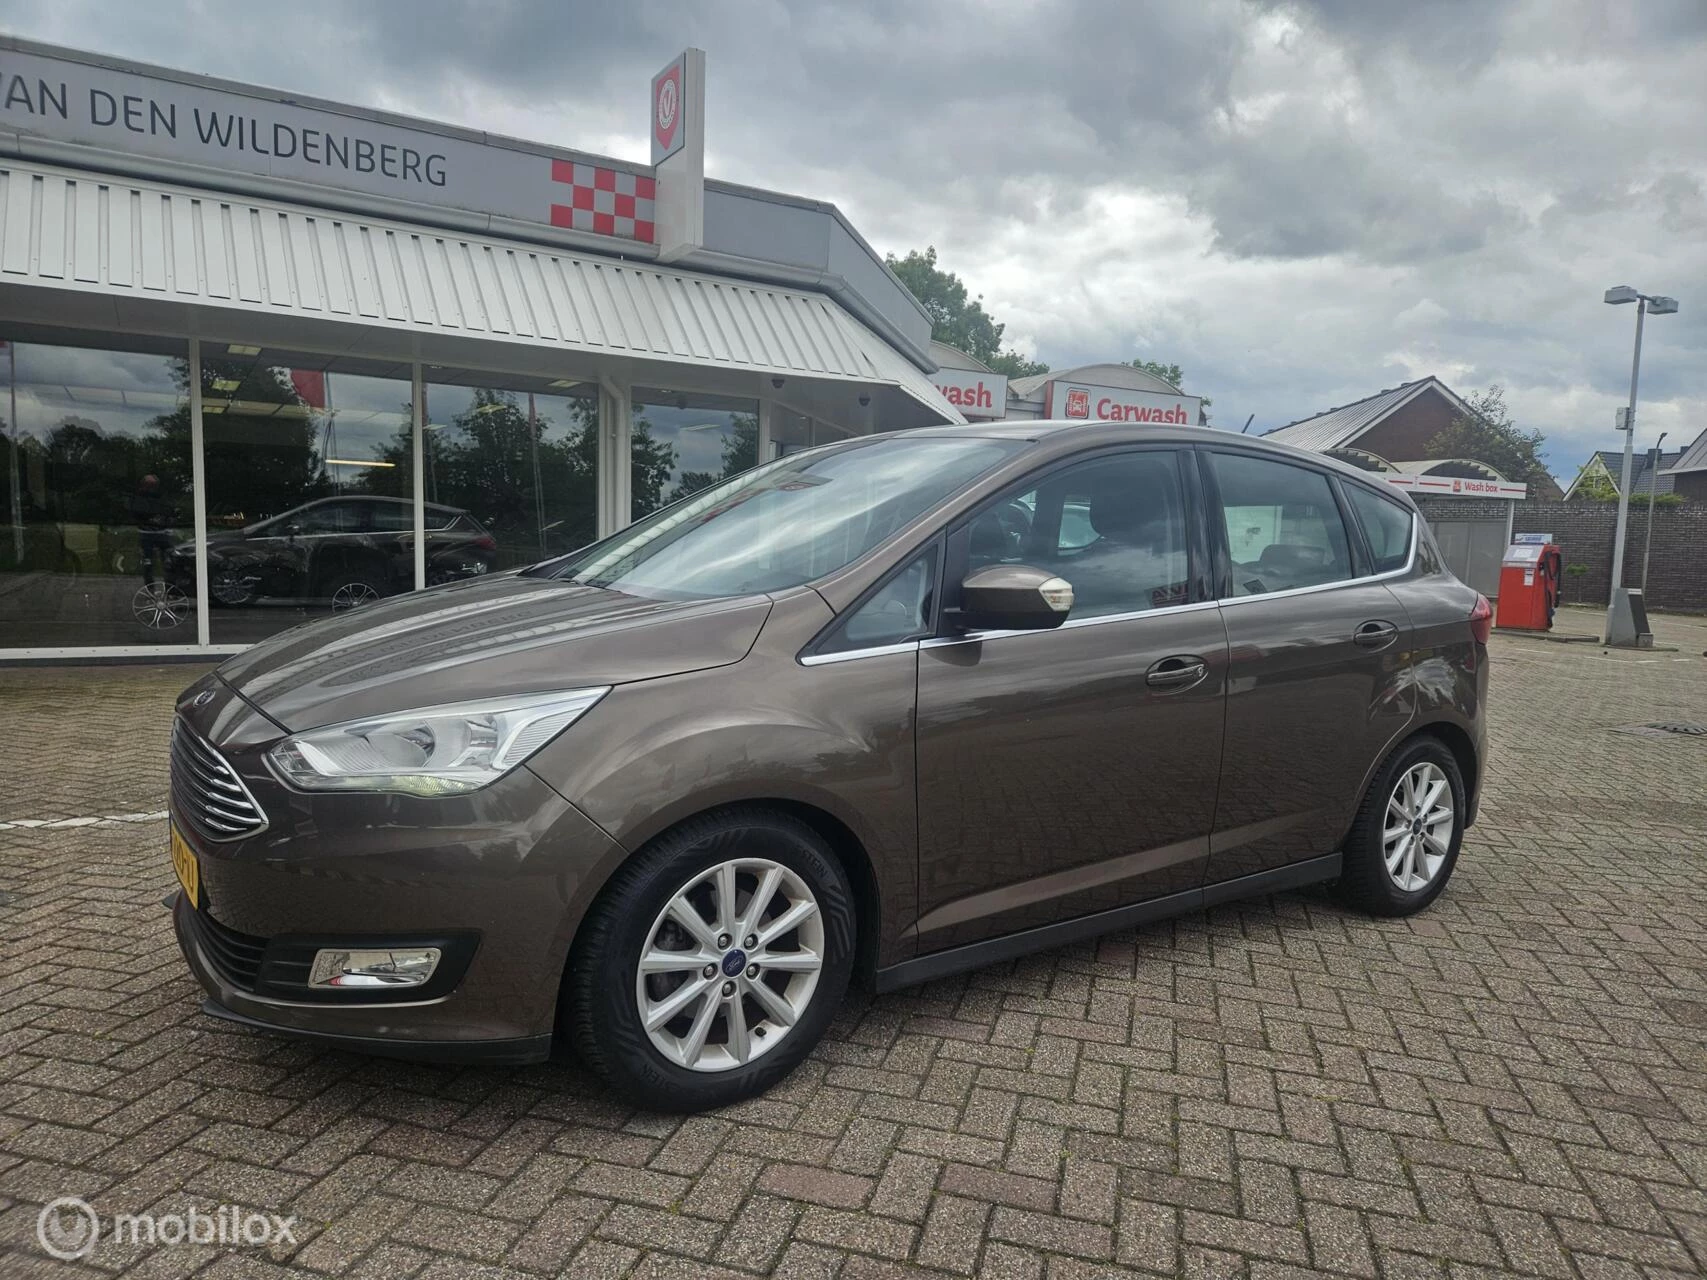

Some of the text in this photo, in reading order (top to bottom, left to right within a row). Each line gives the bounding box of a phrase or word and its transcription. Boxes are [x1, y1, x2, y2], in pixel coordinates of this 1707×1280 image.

[0, 72, 447, 187] AN DEN WILDENBERG
[1096, 398, 1188, 424] Carwash
[1464, 481, 1498, 492] Wash box
